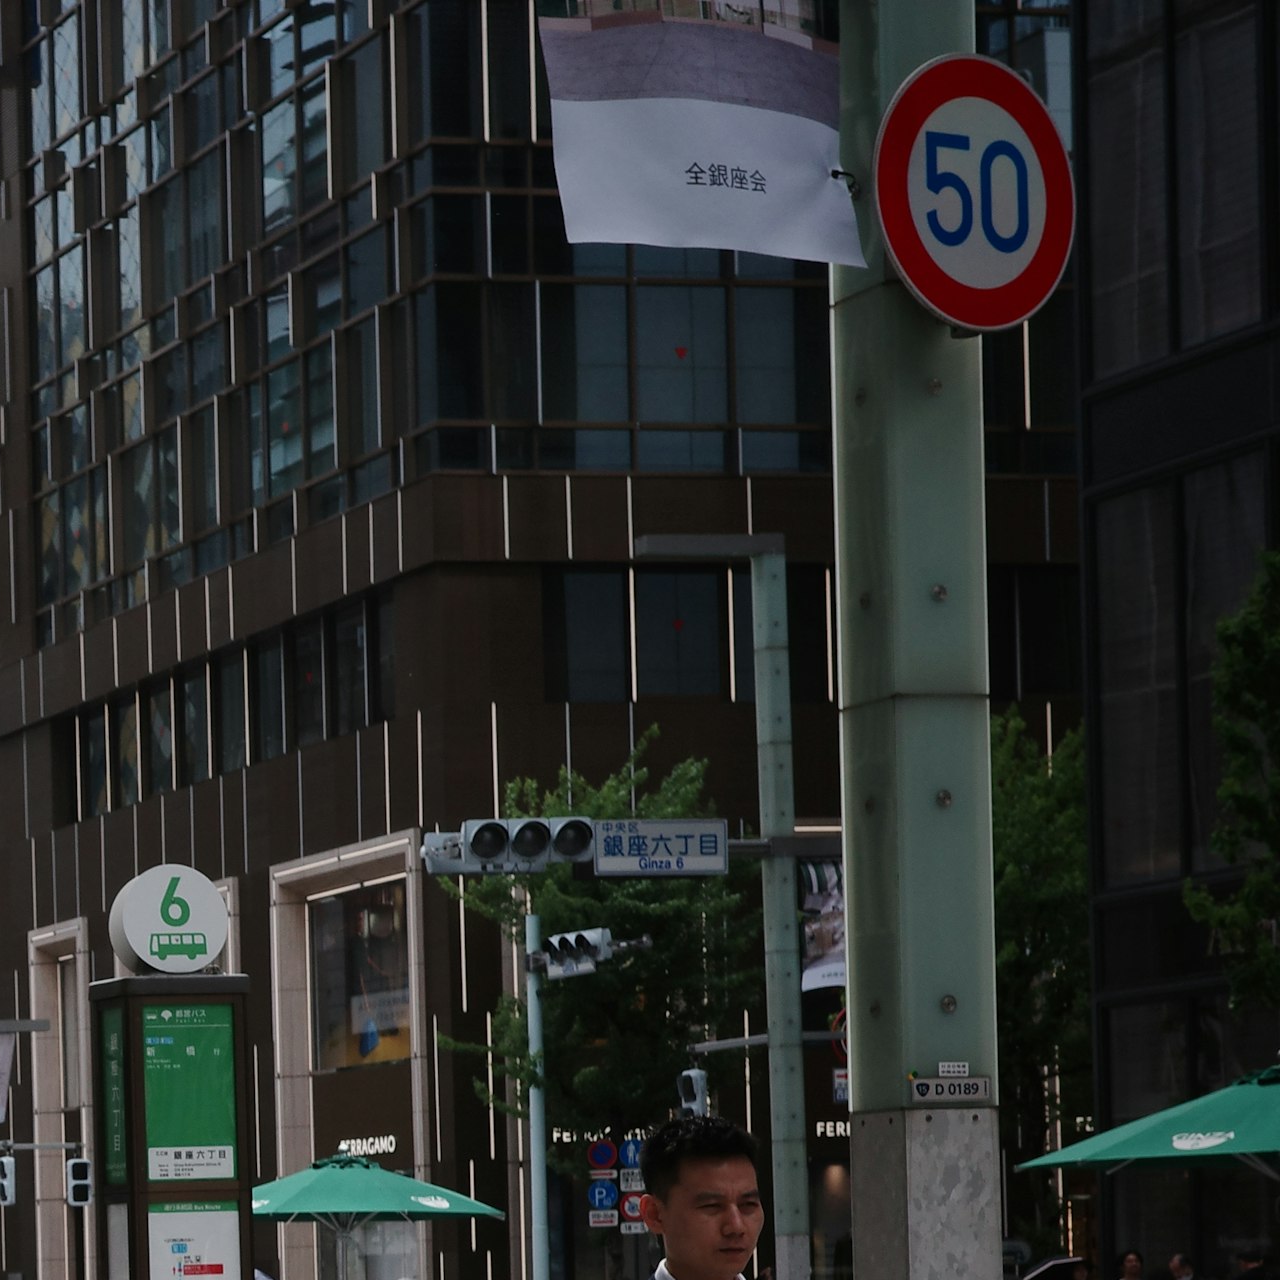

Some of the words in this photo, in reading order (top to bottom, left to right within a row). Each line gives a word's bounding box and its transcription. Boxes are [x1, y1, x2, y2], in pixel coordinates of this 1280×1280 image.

[684, 161, 767, 195] 全銀座会
[925, 130, 1029, 254] 50
[602, 823, 639, 833] 中央区
[604, 833, 718, 857] 銀座六丁目
[639, 857, 671, 870] Ginza
[676, 857, 684, 870] 6
[160, 877, 190, 927] 6
[935, 1083, 944, 1095] D
[948, 1082, 979, 1096] 0189
[173, 1149, 226, 1160] 銀座六丁目
[340, 1134, 396, 1157] ERRAGAMO
[595, 1187, 607, 1208] P
